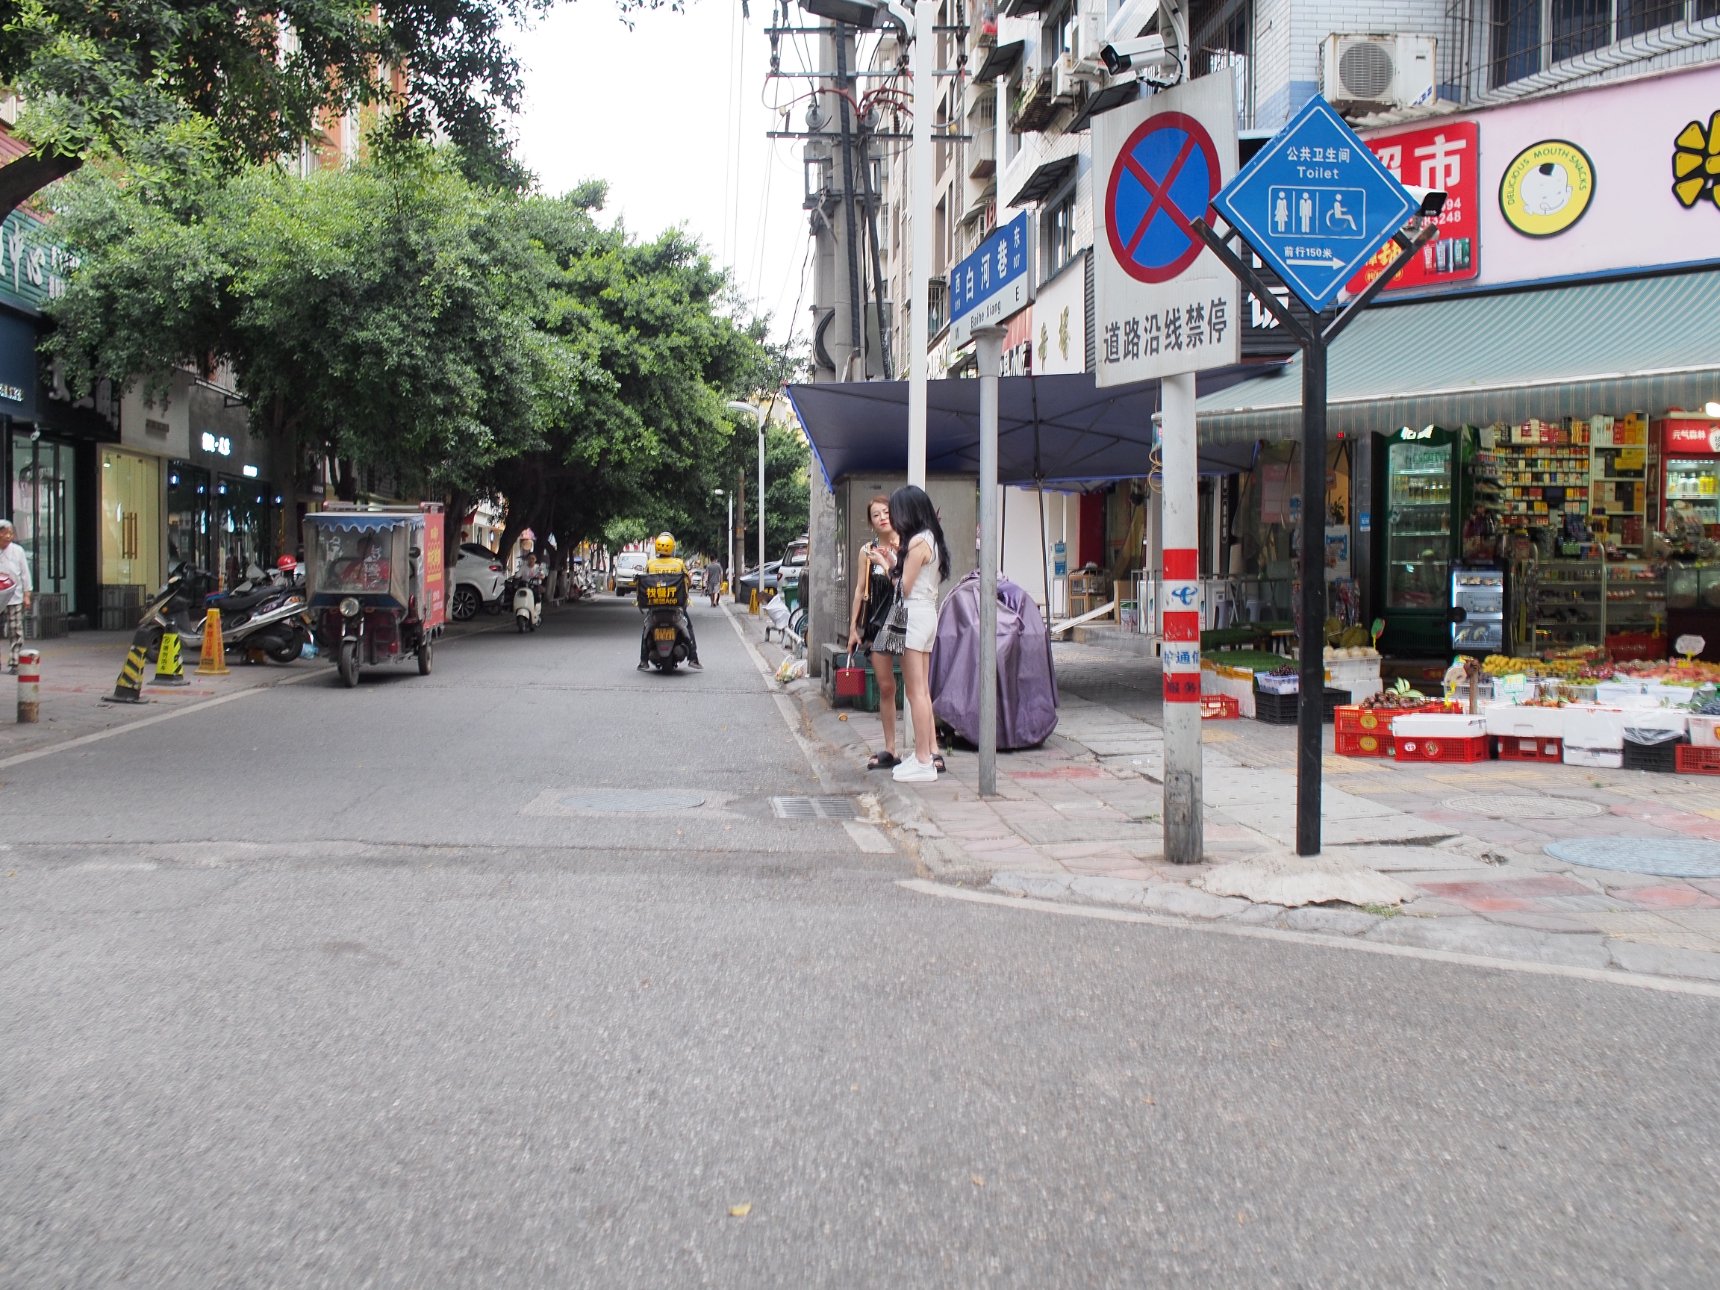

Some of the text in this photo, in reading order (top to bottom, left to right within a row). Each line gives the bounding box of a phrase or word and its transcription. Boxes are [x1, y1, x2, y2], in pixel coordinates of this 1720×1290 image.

[1287, 146, 1350, 163] 公共卫生间
[1375, 134, 1467, 192] 市
[1533, 147, 1570, 159] MOUTH
[1297, 166, 1340, 180] Toilet
[1507, 158, 1530, 206] DELICIOUS
[1569, 155, 1587, 191] SNACKS
[1013, 226, 1021, 249] 东
[1283, 245, 1334, 259] 前行150米
[965, 238, 1009, 303] 白河巷
[955, 272, 961, 295] 西
[1015, 286, 1020, 302] E
[970, 300, 1001, 329] Baihe Xiang
[1103, 297, 1228, 364] 道路沿线禁停
[647, 586, 677, 598] 找餐厅
